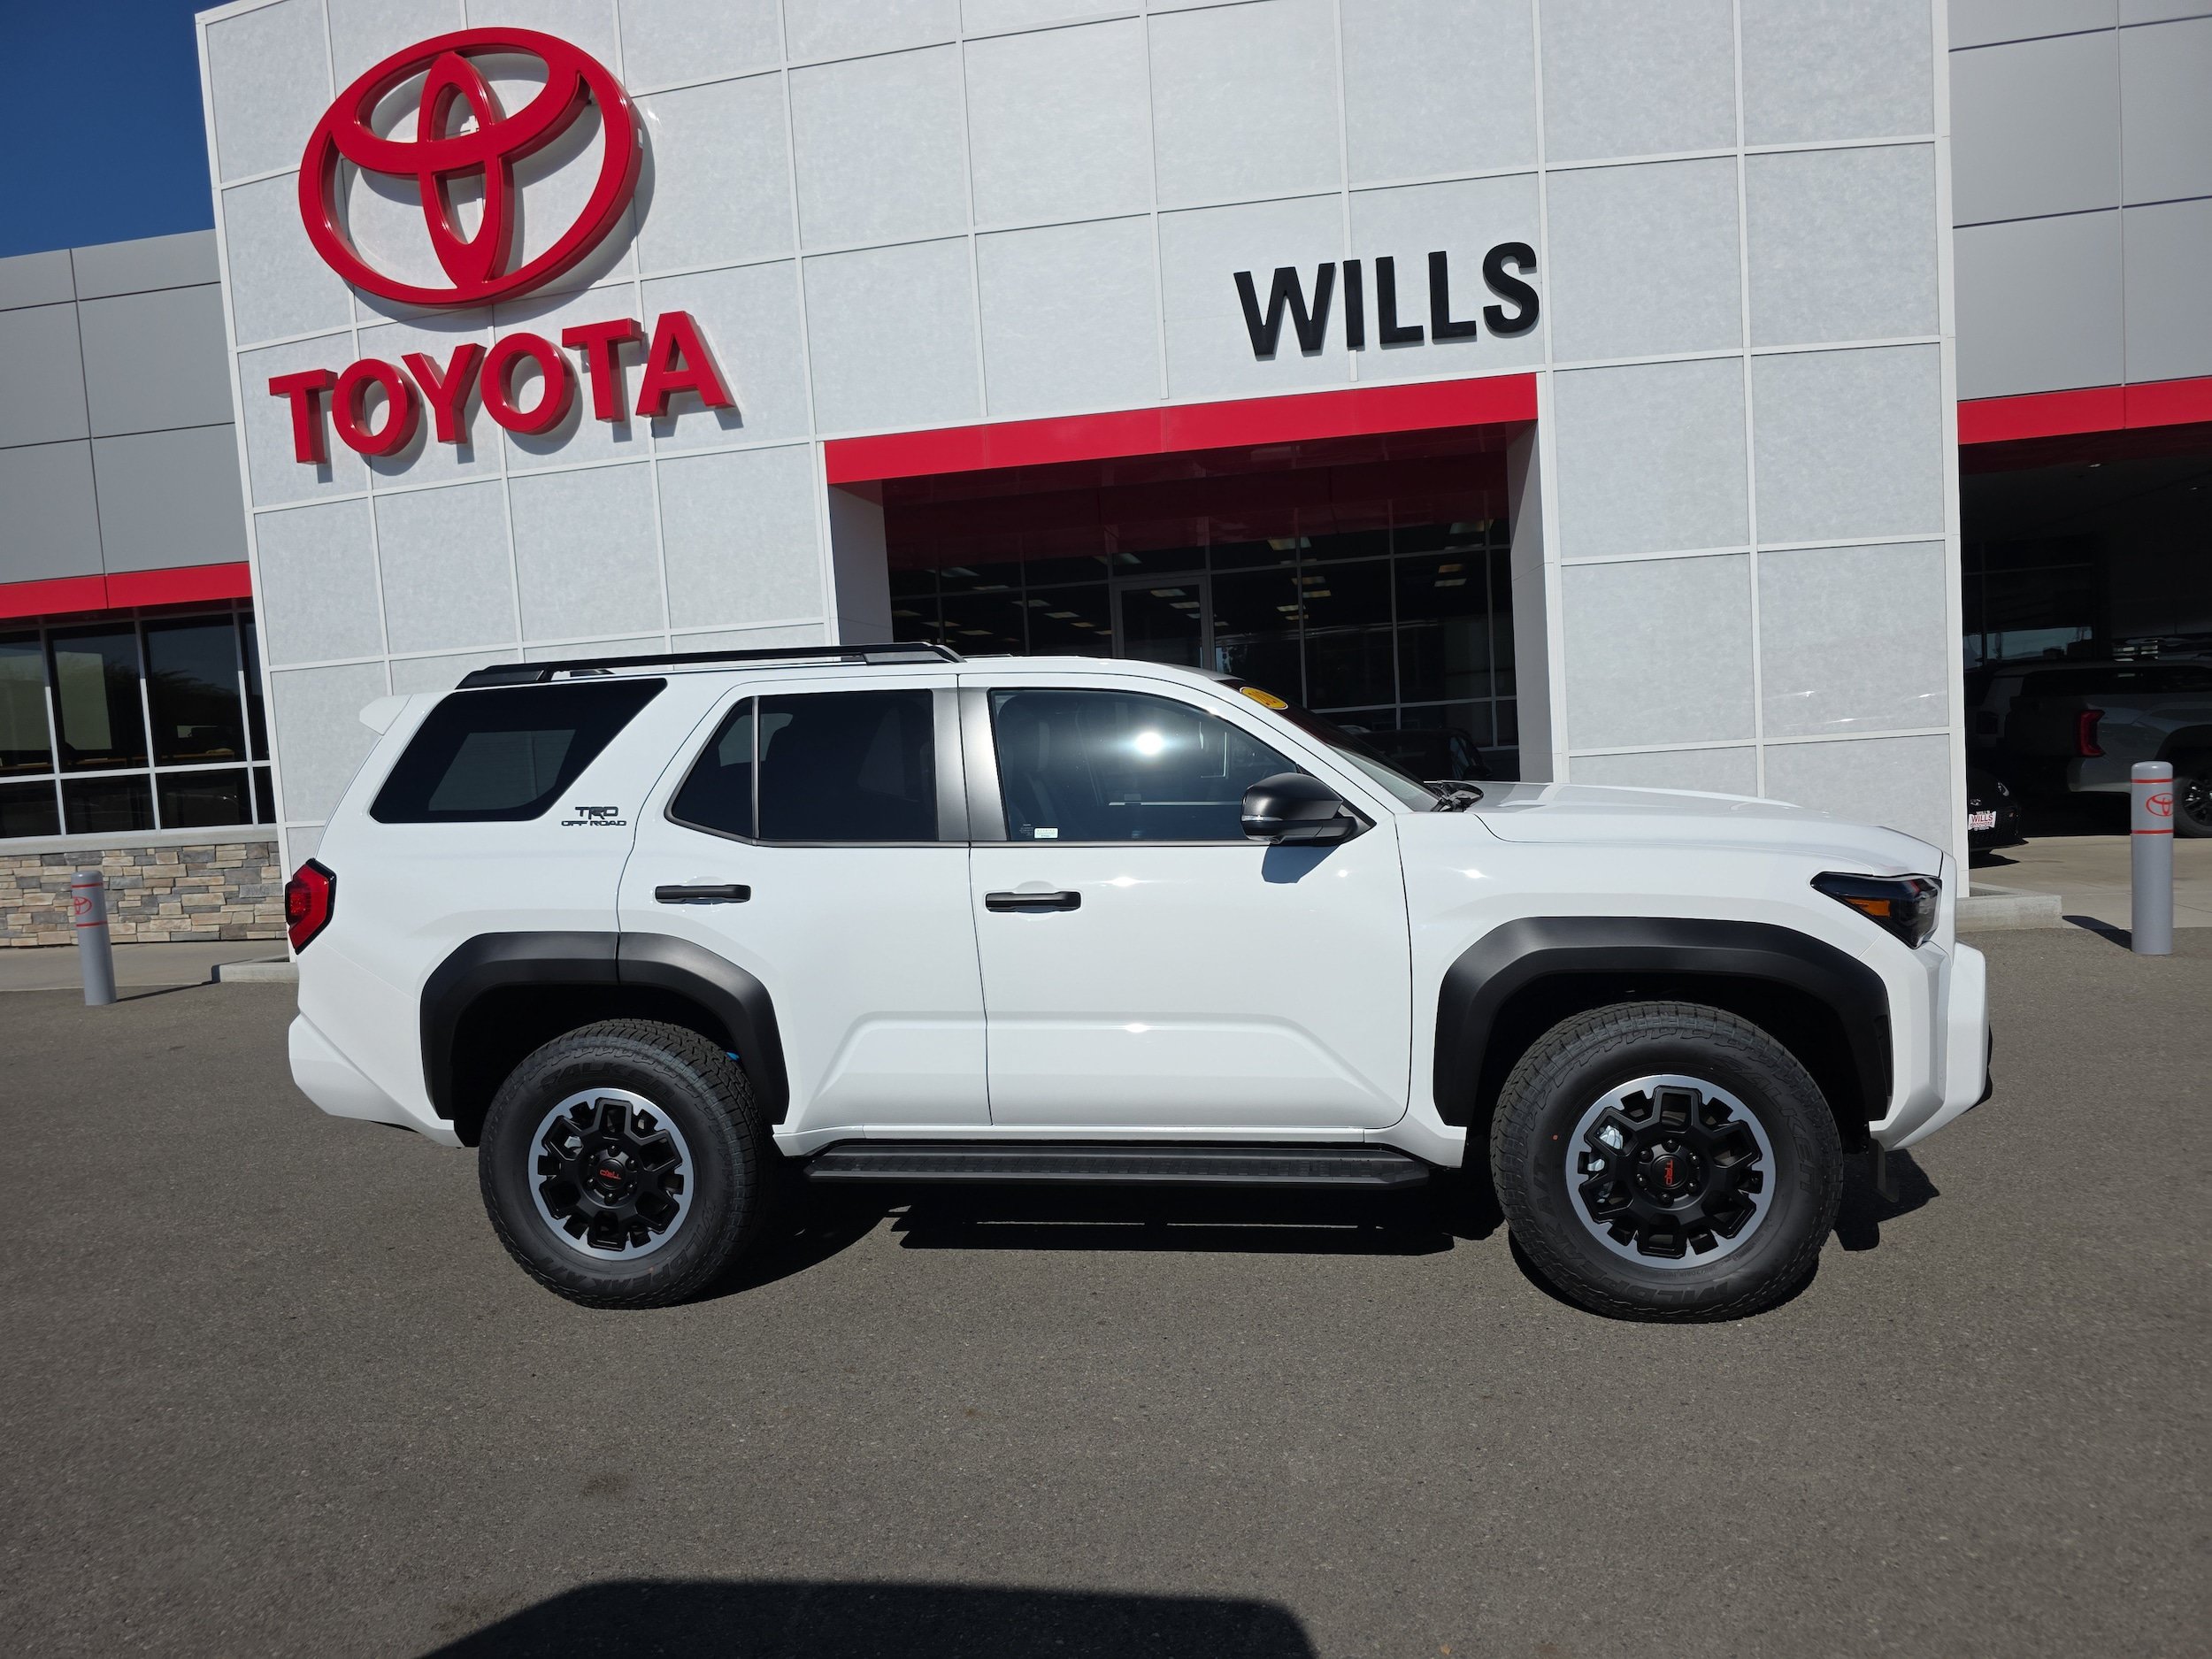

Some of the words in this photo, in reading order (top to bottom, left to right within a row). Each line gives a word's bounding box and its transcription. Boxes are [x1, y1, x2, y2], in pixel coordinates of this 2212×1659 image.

[1233, 242, 1540, 357] WILLS
[269, 311, 735, 465] TOYOTA
[575, 806, 618, 819] TRD
[1713, 1053, 1816, 1192] FALKEN
[1664, 1159, 1673, 1186] TRD
[592, 1202, 718, 1292] WILDPEAK
[1544, 1222, 1732, 1305] WILDPEAK
